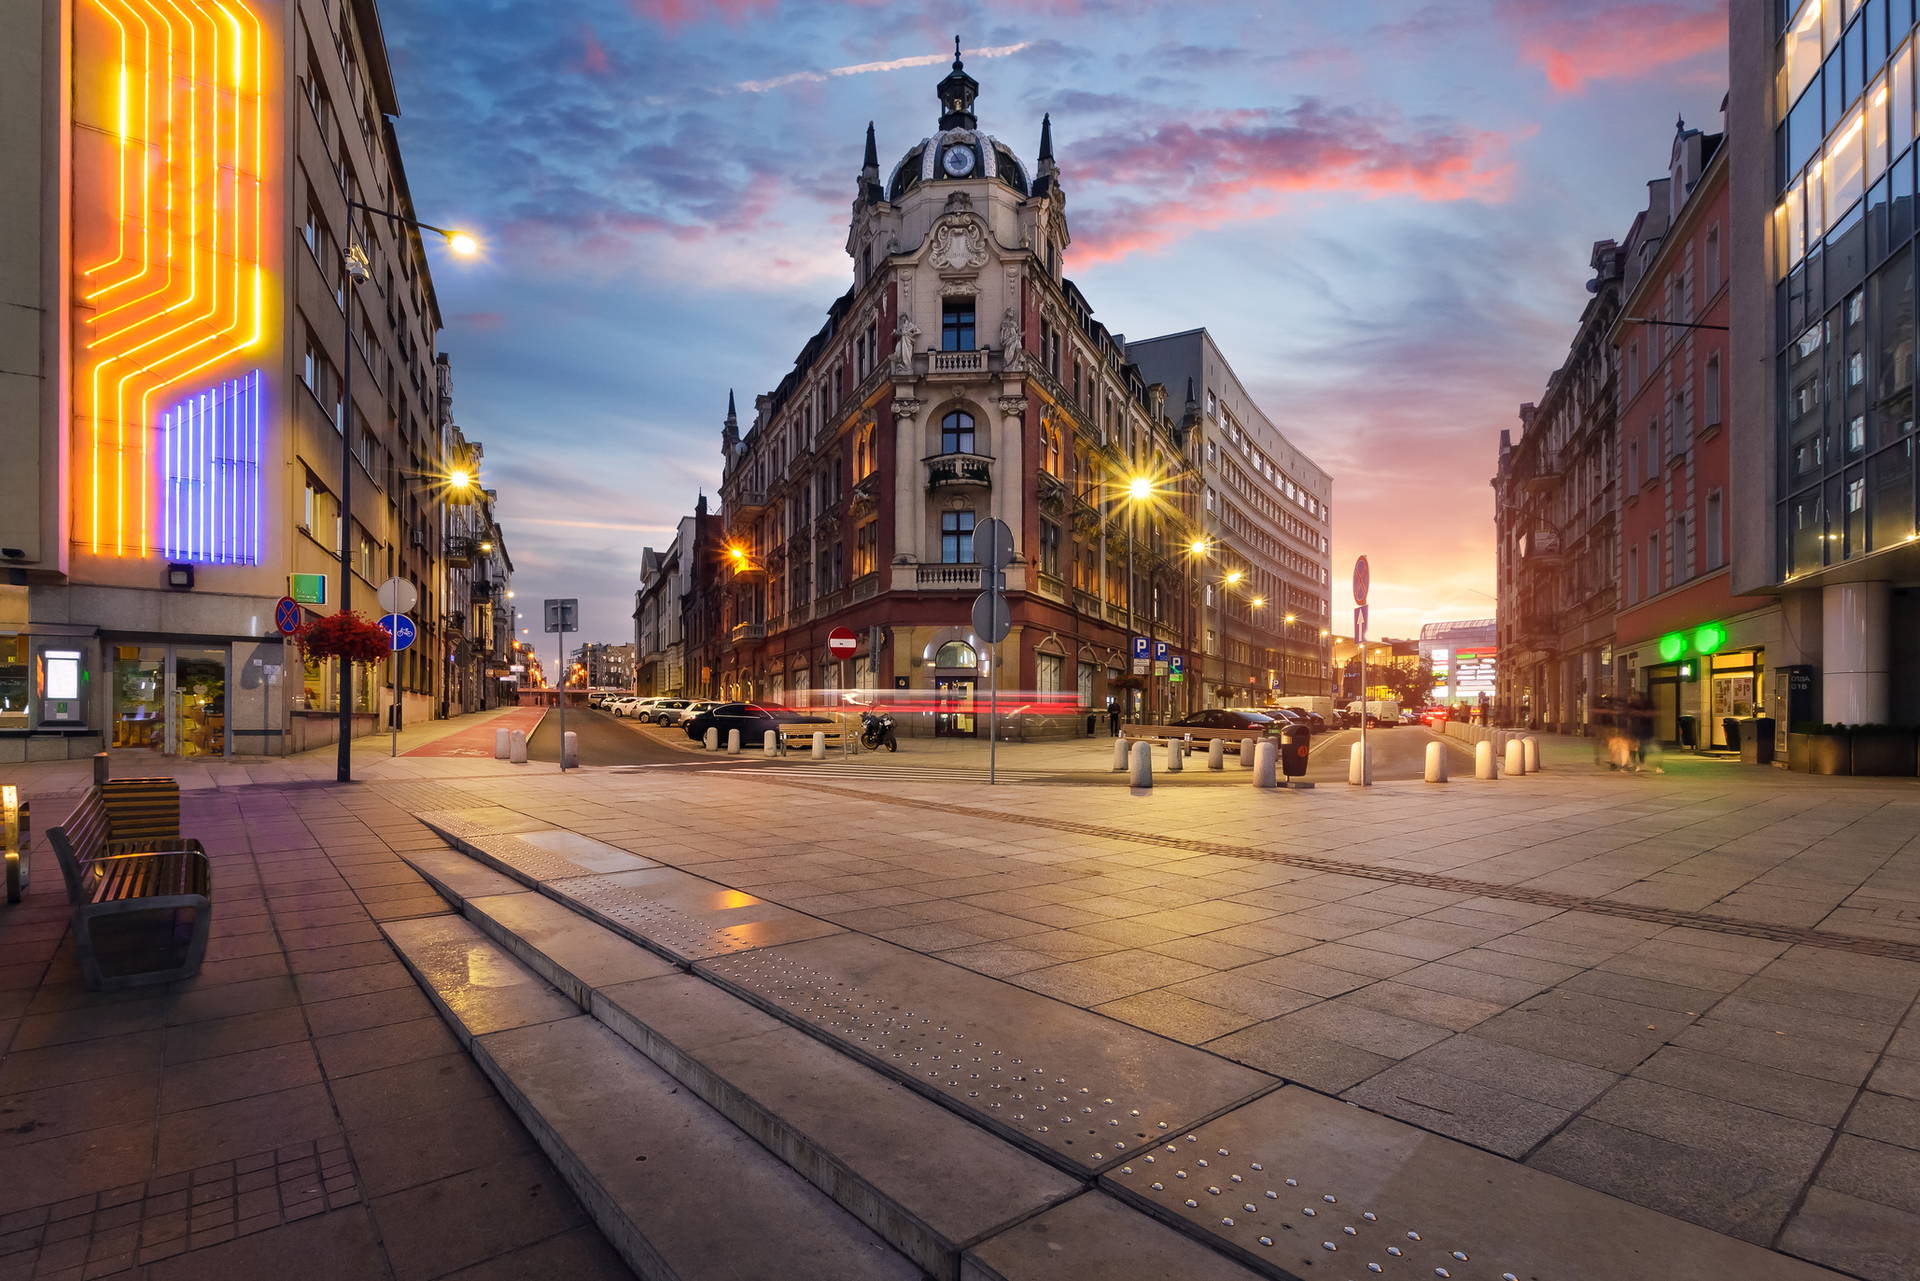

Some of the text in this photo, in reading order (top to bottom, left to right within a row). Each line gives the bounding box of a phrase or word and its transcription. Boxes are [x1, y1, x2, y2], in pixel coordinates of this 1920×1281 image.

[1137, 639, 1147, 653] P
[1157, 643, 1166, 656] P
[1173, 657, 1181, 669] P
